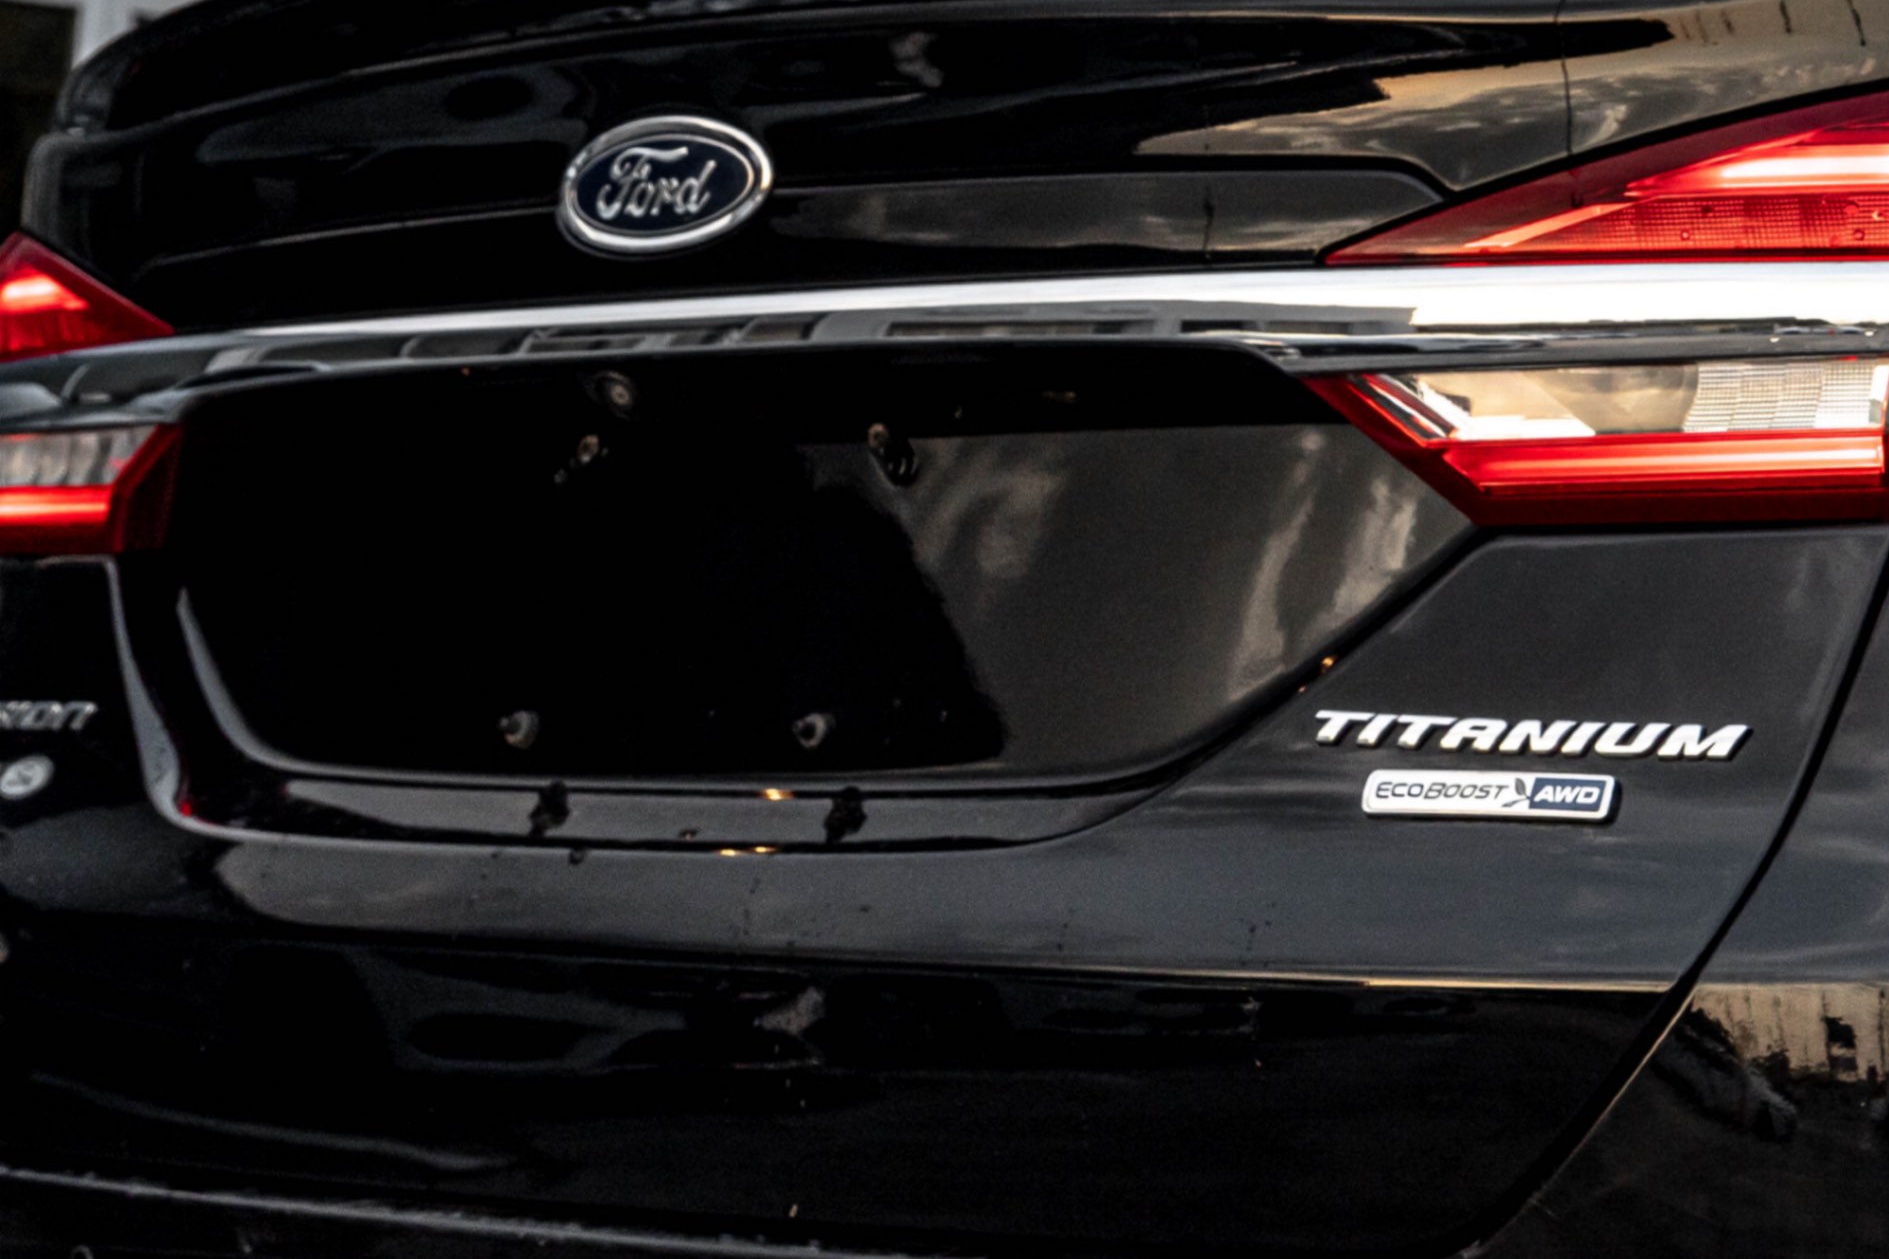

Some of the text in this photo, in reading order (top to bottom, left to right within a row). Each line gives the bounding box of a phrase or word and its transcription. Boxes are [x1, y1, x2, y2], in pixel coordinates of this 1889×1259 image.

[596, 146, 717, 220] Ford
[1314, 709, 1751, 758] TITANIUM
[1533, 784, 1601, 805] AWD
